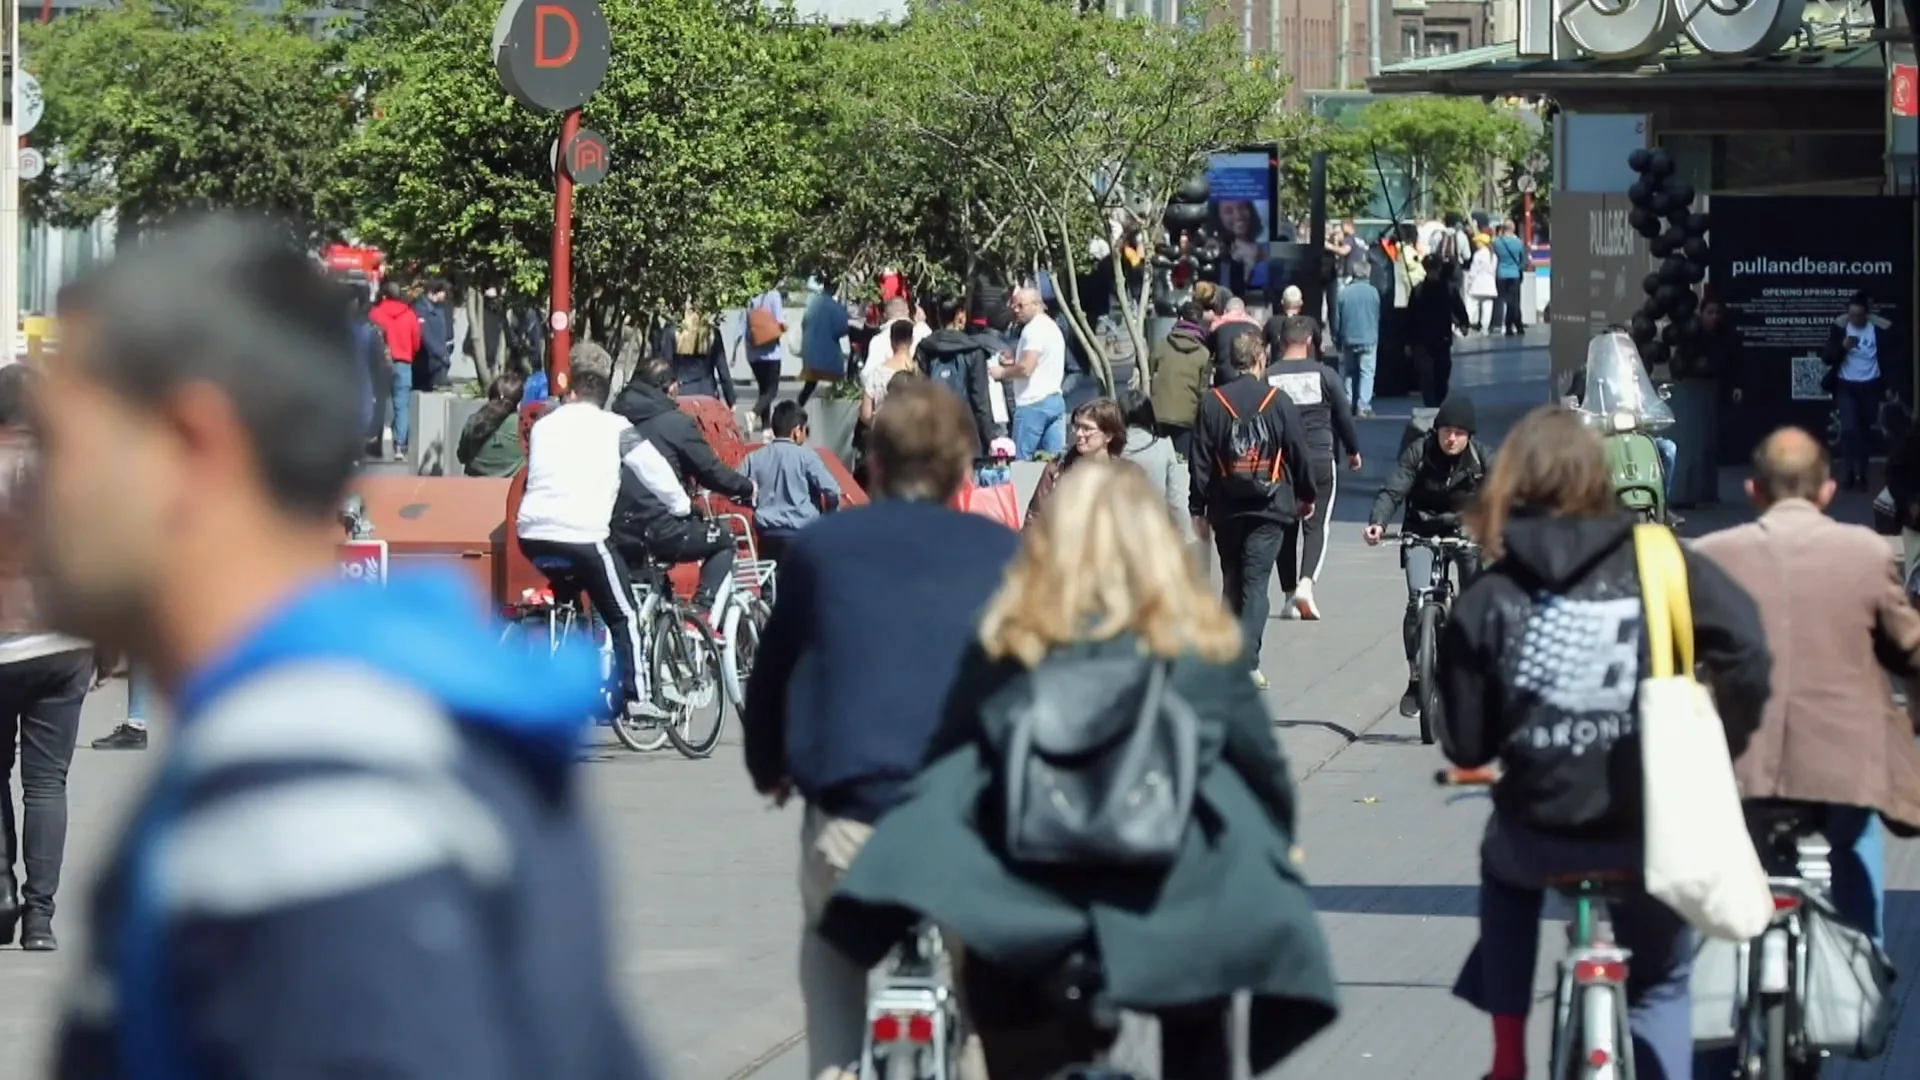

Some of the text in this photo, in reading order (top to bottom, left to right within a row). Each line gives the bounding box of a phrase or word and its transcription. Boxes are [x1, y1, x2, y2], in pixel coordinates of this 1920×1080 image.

[535, 5, 581, 67] D
[1732, 257, 1893, 277] pullandbear.com
[1762, 288, 1803, 297] OPENING
[1804, 288, 1836, 297] SPRING
[1765, 316, 1807, 325] GEOPEND
